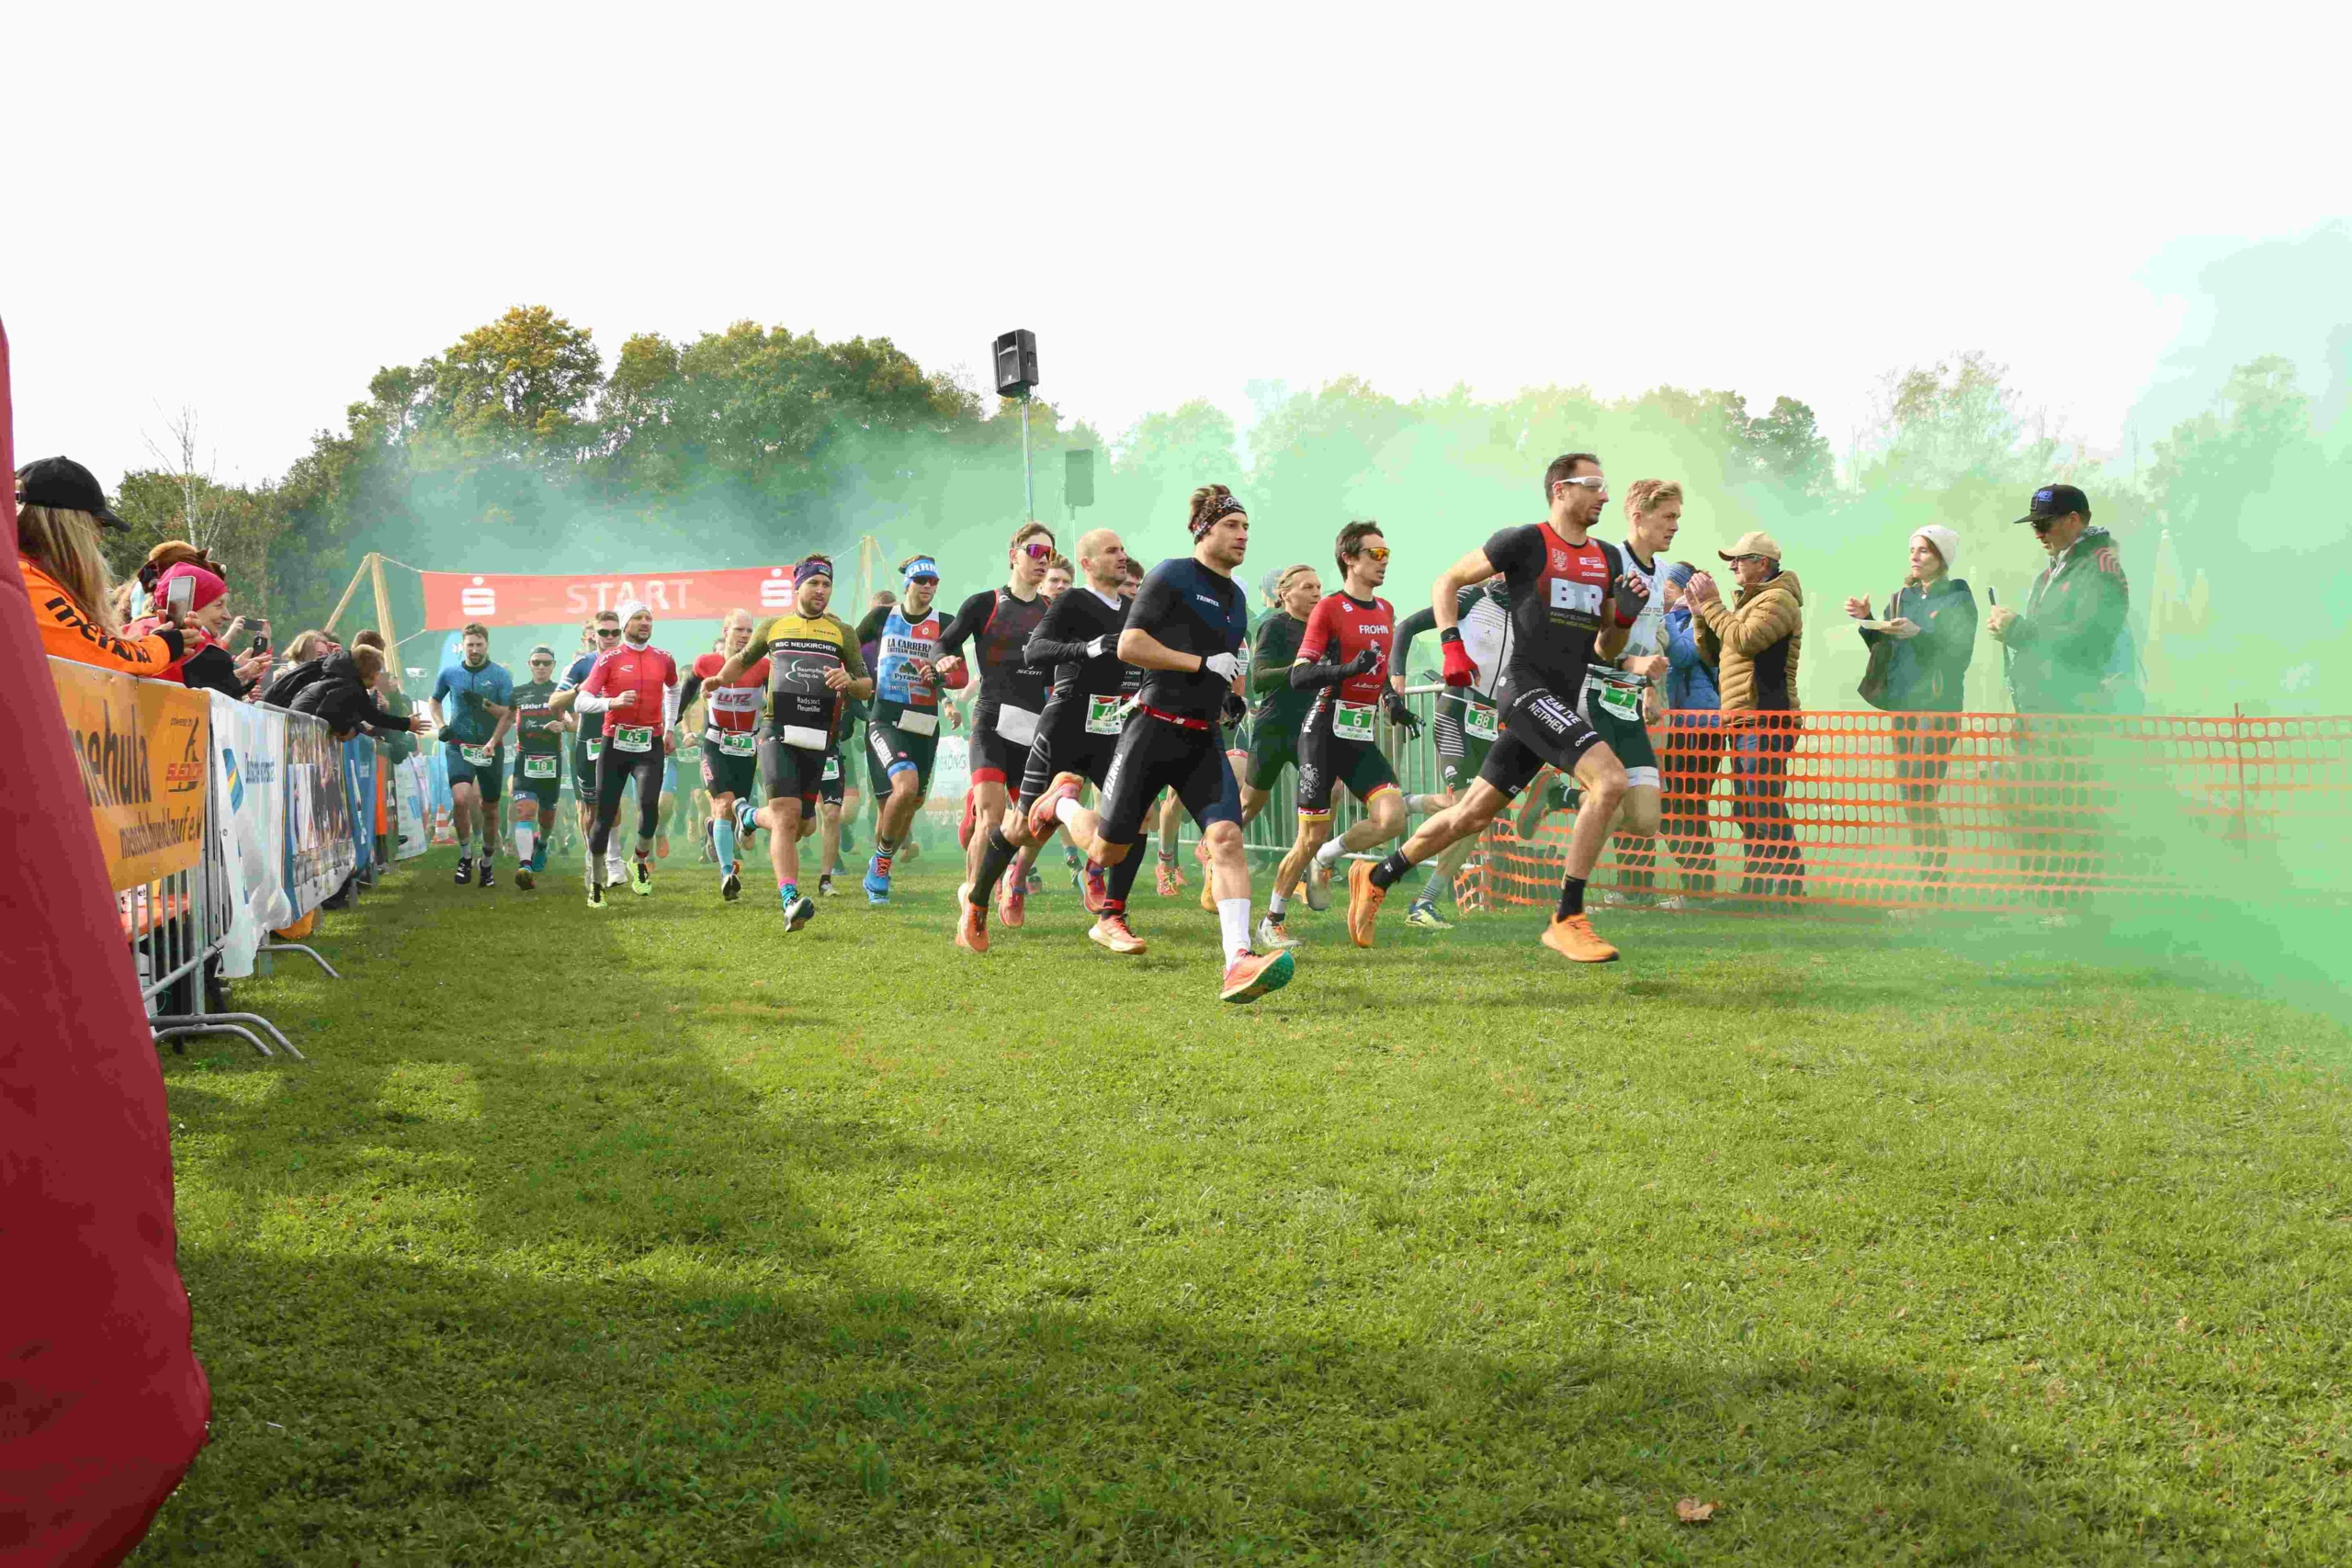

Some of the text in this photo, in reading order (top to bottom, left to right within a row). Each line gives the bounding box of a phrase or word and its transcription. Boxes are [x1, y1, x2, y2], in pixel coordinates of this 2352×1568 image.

[565, 579, 695, 614] START
[1196, 593, 1220, 607] TRIMTEX
[1359, 625, 1389, 635] FROHN
[791, 641, 837, 653] NEUKIRCHEN
[888, 637, 896, 648] LA
[1543, 694, 1582, 724] TEAM TVE
[1353, 713, 1363, 727] 6
[1475, 713, 1490, 728] 88
[1527, 702, 1566, 735] NETPHEN
[626, 732, 641, 743] 45
[731, 738, 745, 748] 87
[535, 761, 548, 771] 18
